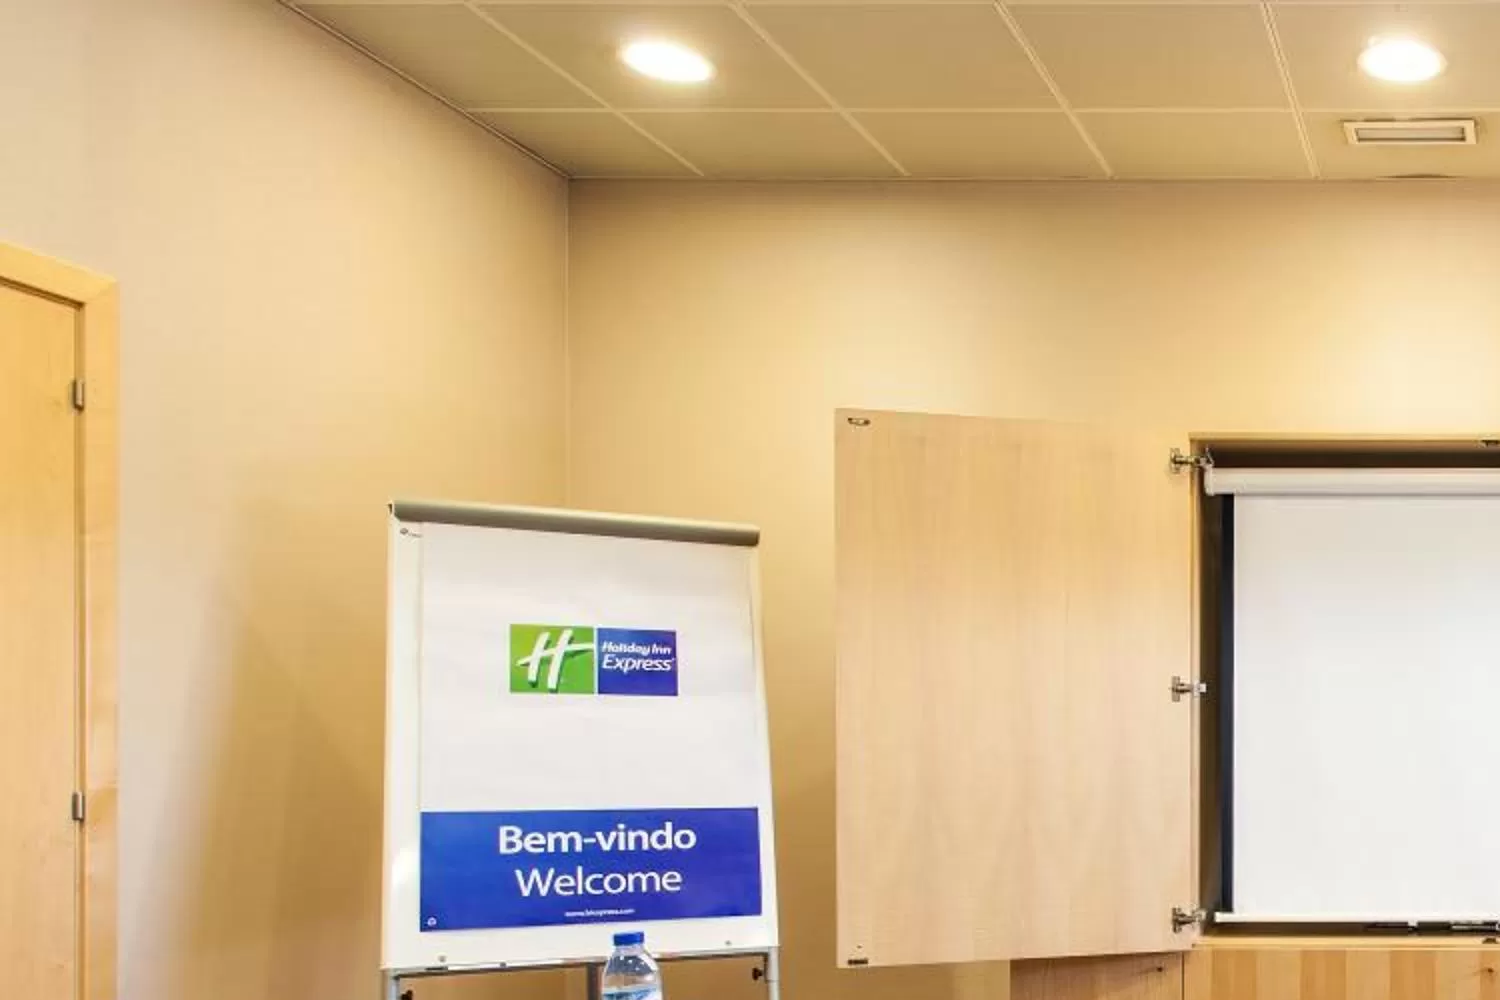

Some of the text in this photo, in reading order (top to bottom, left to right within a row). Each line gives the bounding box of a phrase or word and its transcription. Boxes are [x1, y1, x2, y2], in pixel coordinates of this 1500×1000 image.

[601, 640, 673, 656] Holiday Inn
[602, 653, 673, 675] Express
[498, 821, 697, 855] Bem-vindo
[514, 866, 683, 897] Welcome
